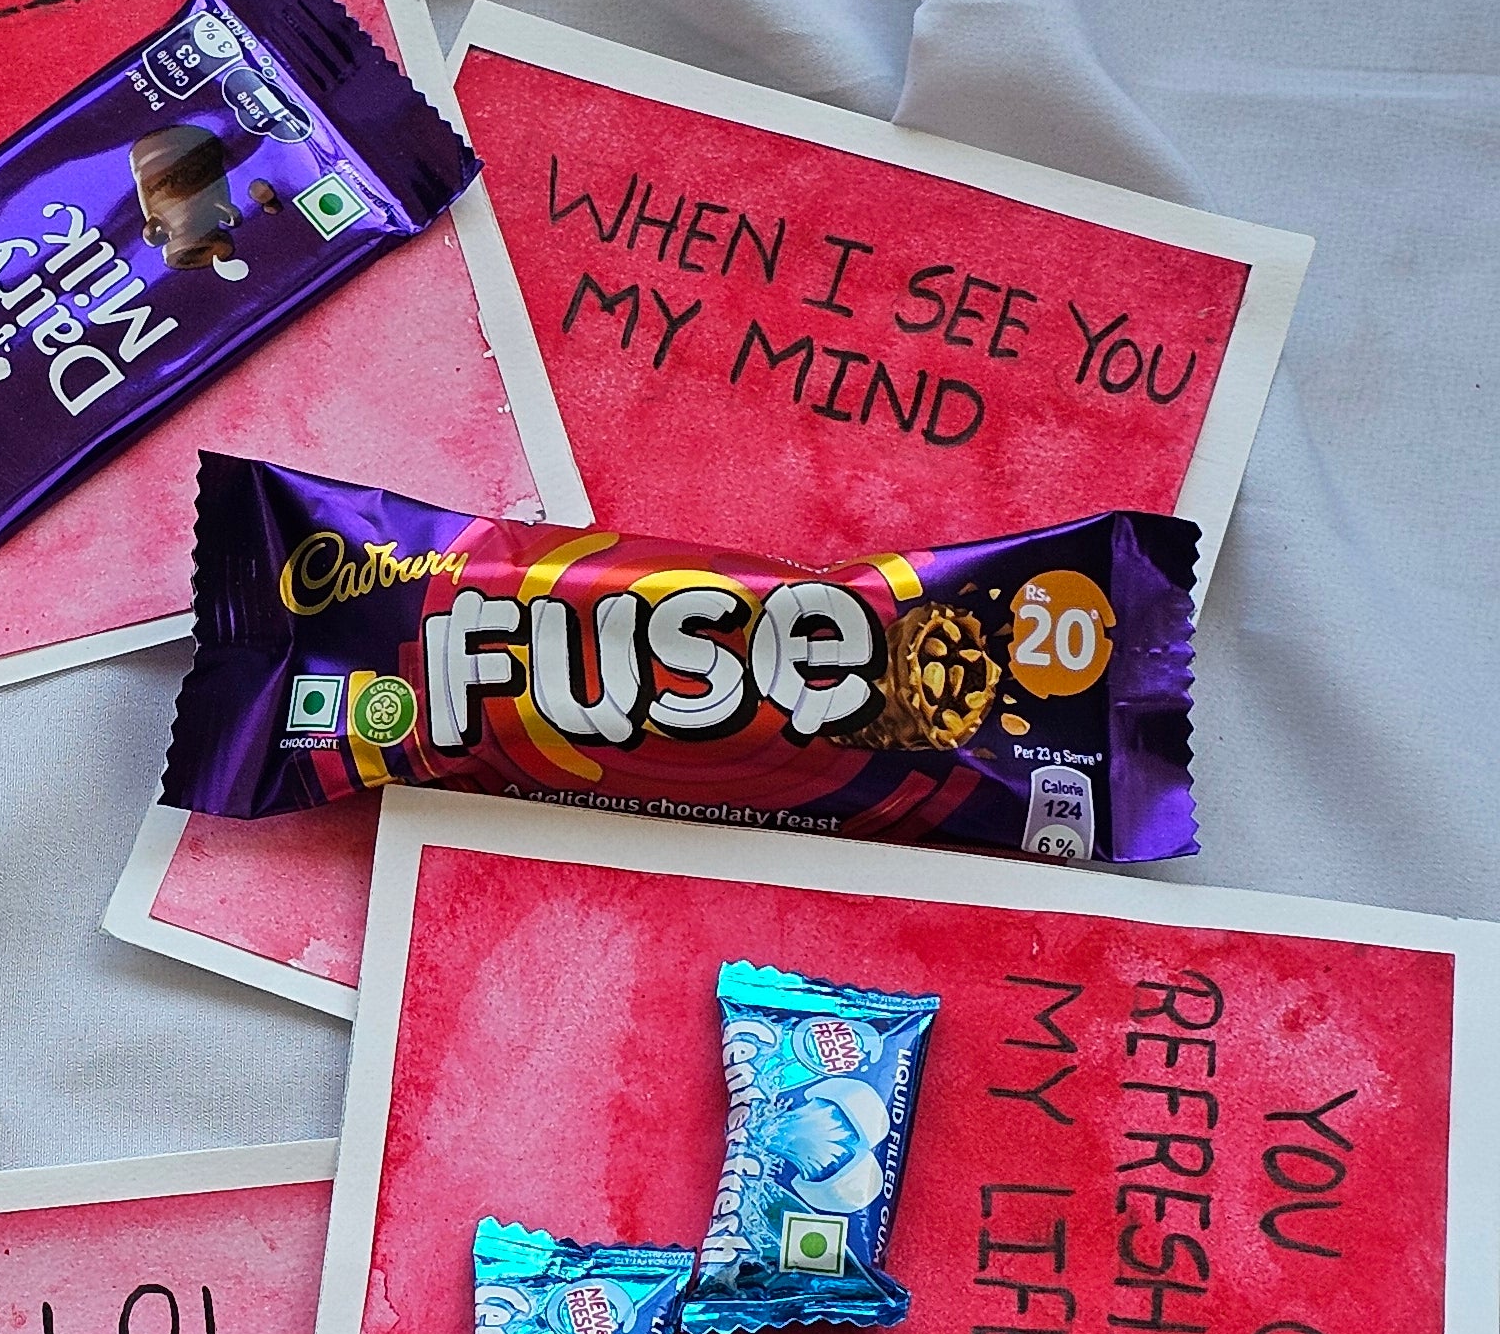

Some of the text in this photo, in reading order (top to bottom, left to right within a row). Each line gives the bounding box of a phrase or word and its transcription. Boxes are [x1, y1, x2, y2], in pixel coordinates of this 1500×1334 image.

[156, 50, 190, 87] Calorie
[175, 44, 201, 68] 63
[217, 41, 233, 54] 3
[124, 69, 166, 112] Per Bar
[42, 203, 178, 363] Milk
[550, 154, 1196, 404] WHEN I SEE YOU
[561, 273, 984, 447] MY MIND
[279, 531, 469, 616] Cadbury
[1025, 584, 1051, 603] Rs.
[367, 729, 394, 739] LIFE
[1014, 745, 1034, 759] Per
[1036, 747, 1051, 760] 23
[1053, 752, 1061, 764] g
[503, 784, 842, 832] A delicious chocolaty feast
[1042, 779, 1083, 796] Calorie
[1044, 800, 1082, 820] 124
[1037, 837, 1076, 858] 6 %
[812, 1023, 844, 1073] FRESH
[987, 974, 1086, 1125] MY
[700, 1021, 776, 1264] Center fresh
[874, 1048, 912, 1263] LIQUID FILLED GUM
[1260, 1089, 1357, 1258] YOU
